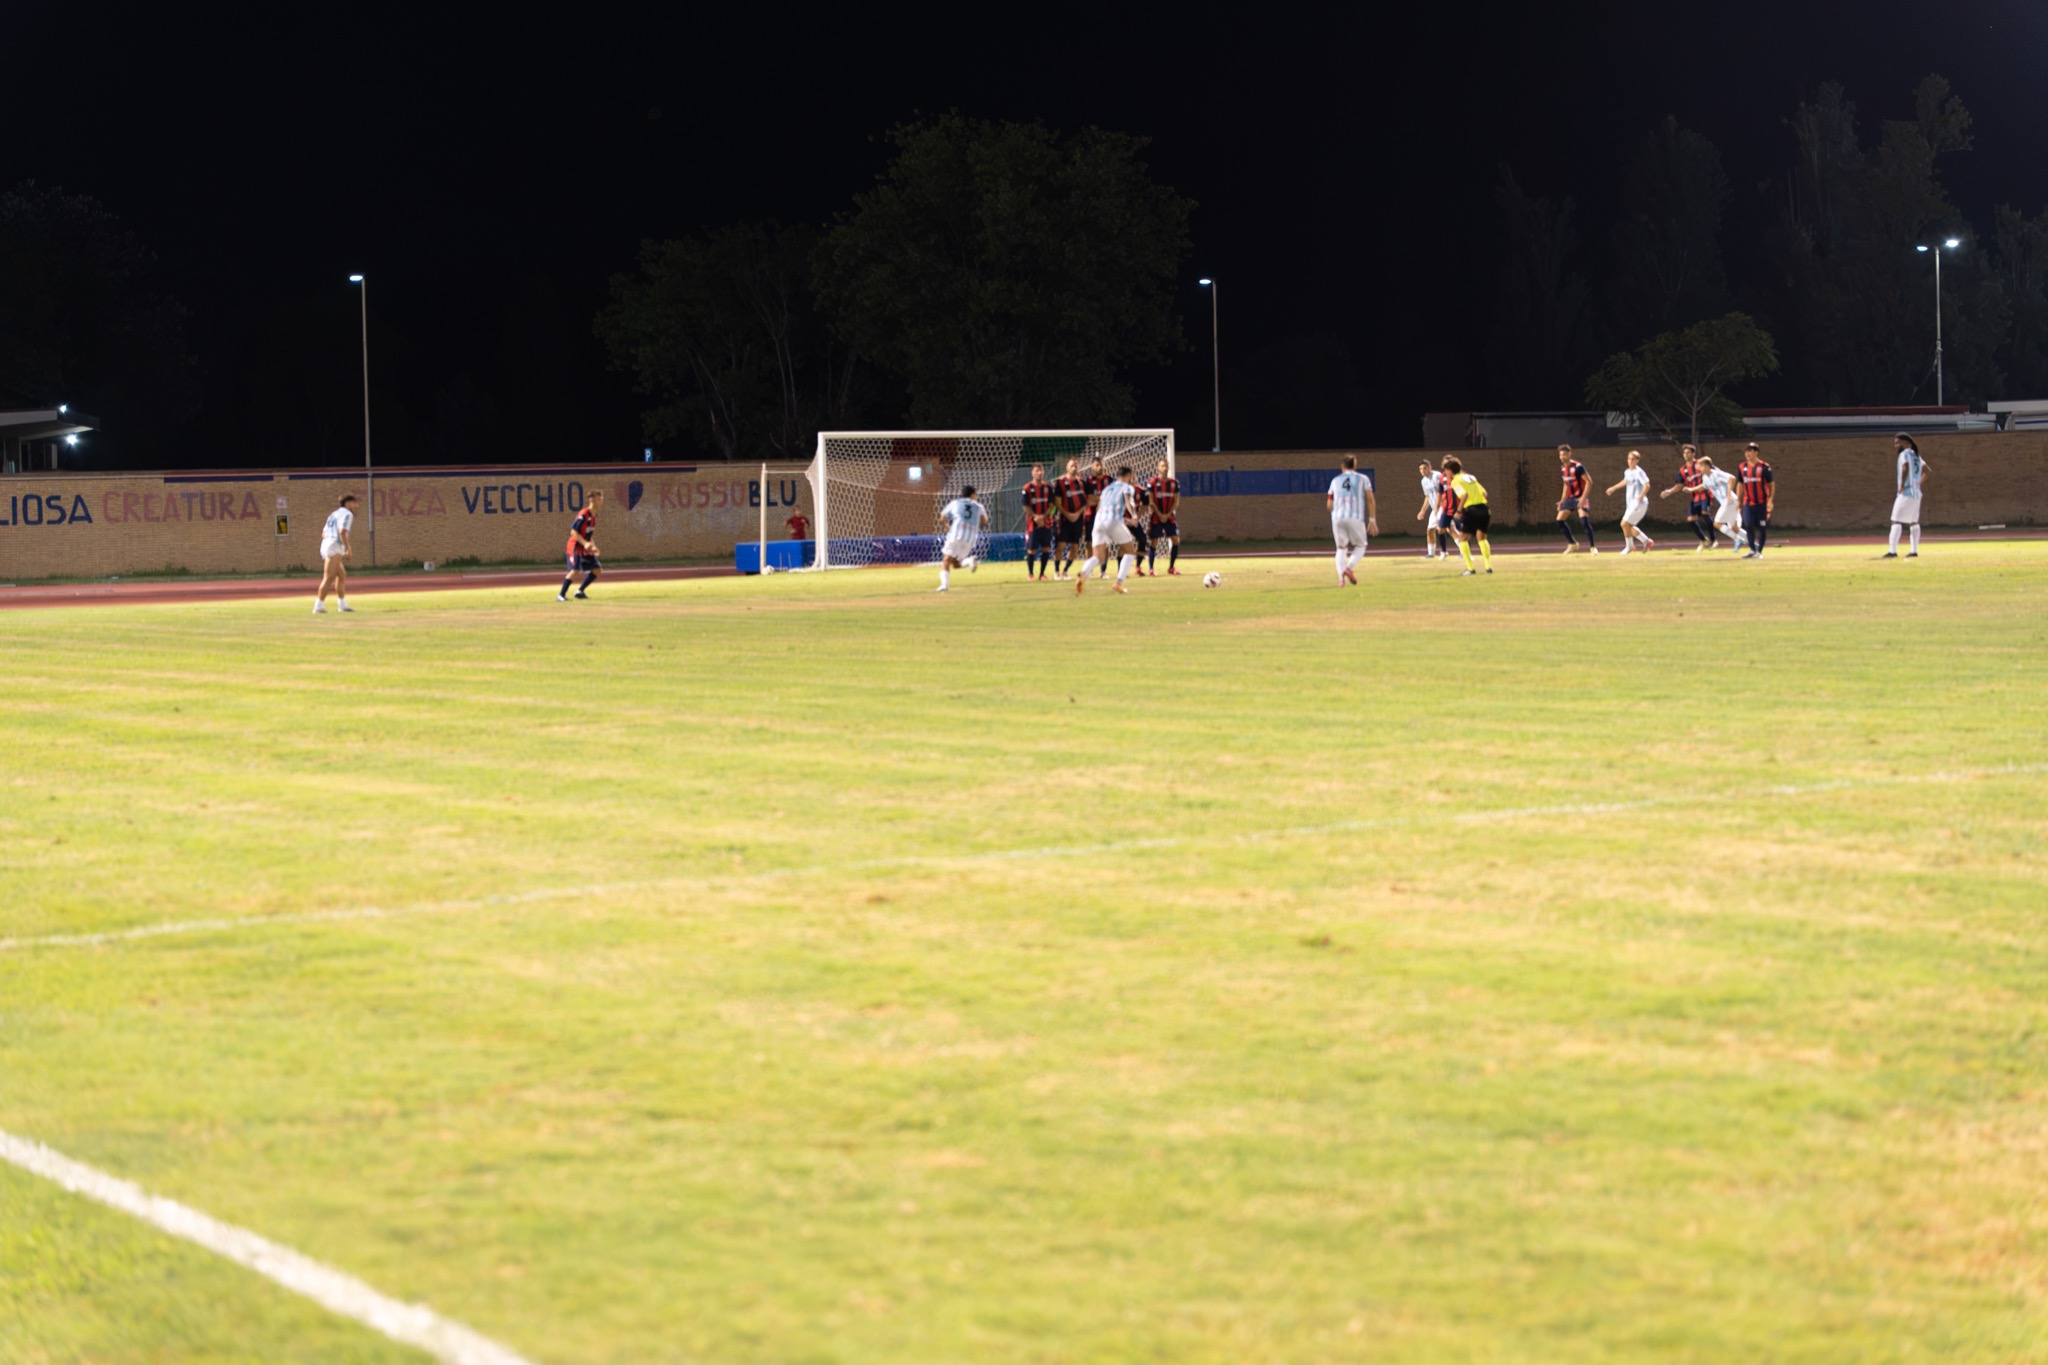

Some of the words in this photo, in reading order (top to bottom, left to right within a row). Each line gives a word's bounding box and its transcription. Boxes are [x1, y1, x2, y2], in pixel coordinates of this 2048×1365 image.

[1342, 476, 1351, 492] 4
[103, 490, 262, 524] CREATURA
[461, 481, 584, 514] VECCHIO
[964, 504, 972, 520] 3
